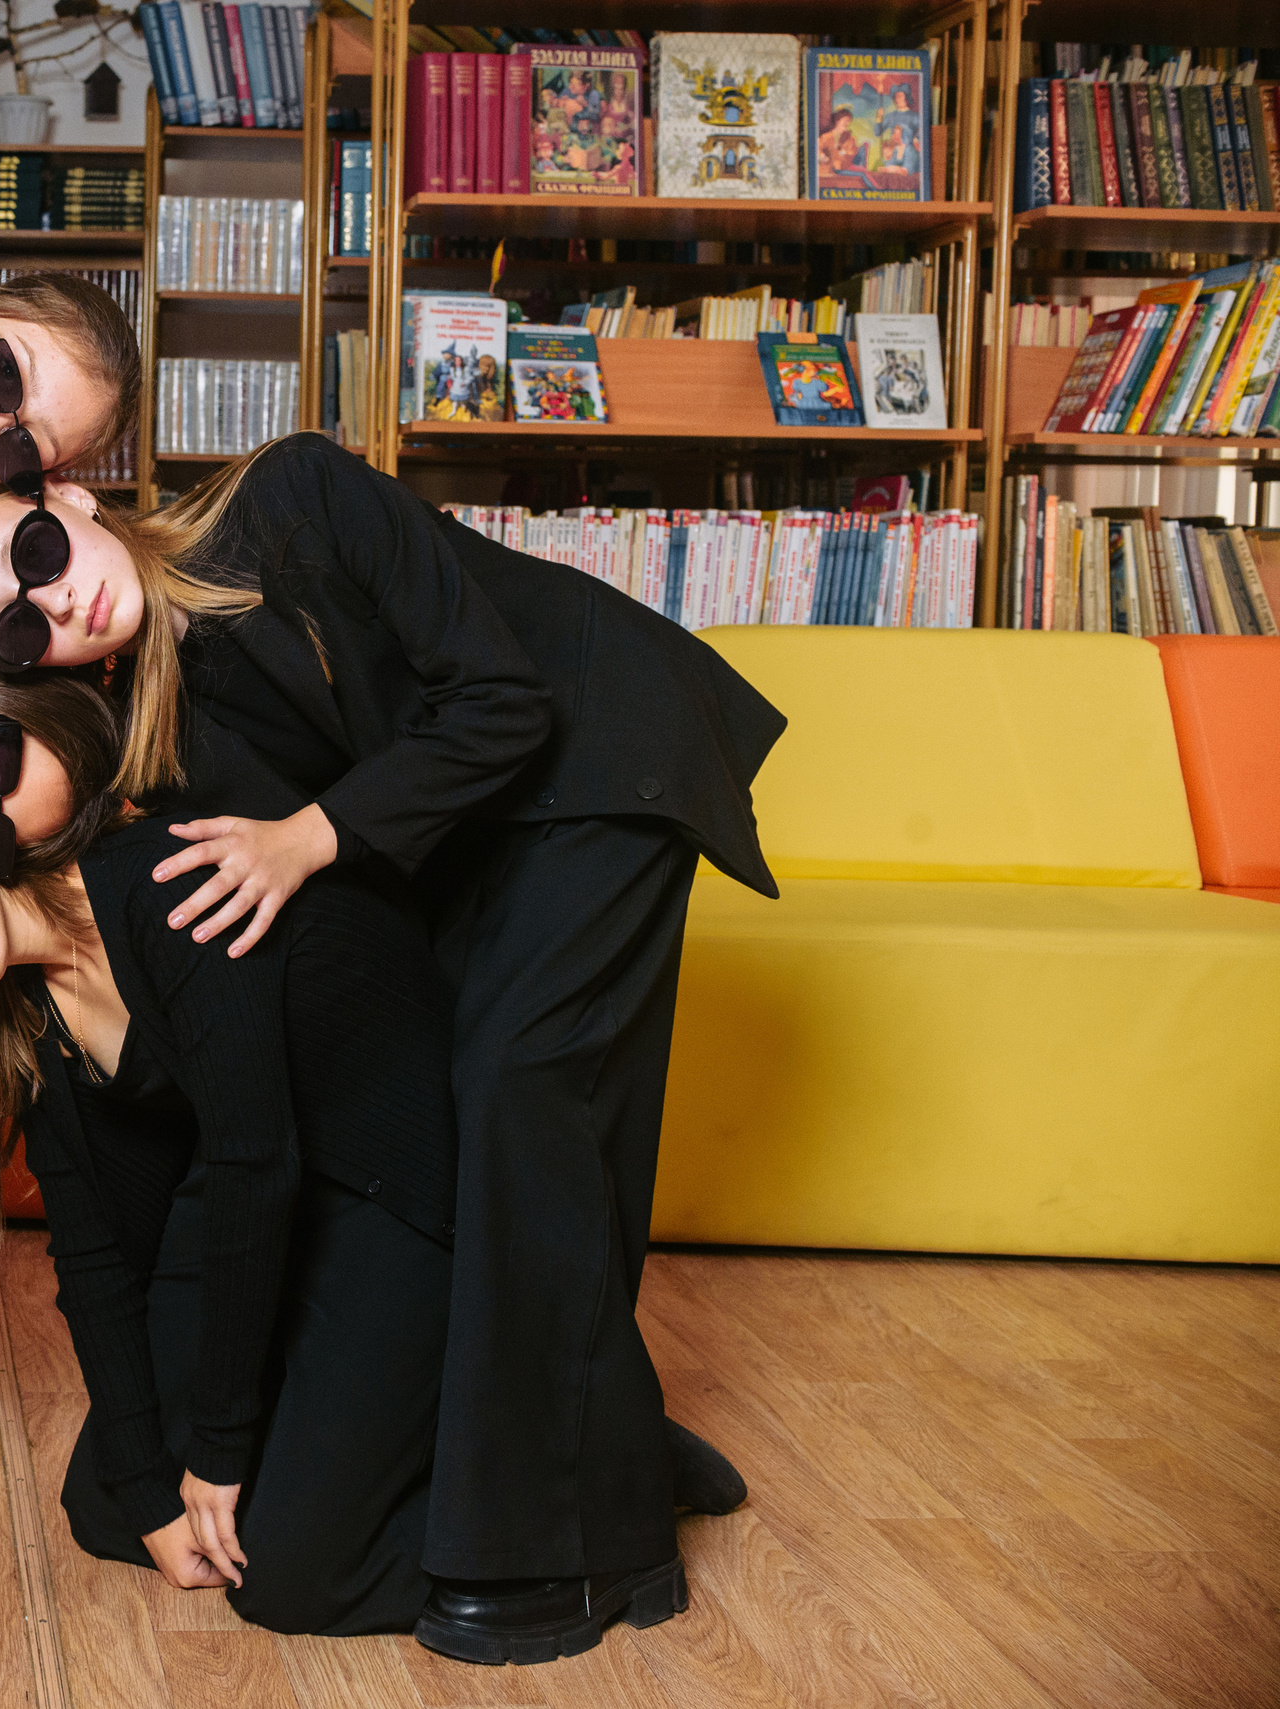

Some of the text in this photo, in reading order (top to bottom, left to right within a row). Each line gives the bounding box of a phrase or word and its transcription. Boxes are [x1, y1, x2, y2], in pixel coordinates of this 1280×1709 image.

[531, 49, 637, 67] ЗОЛОТАЯ КНИГА
[817, 53, 922, 70] ЗОЛОТАЯ КНИГА
[537, 182, 578, 193] СКАЗОК
[822, 190, 863, 199] СКАЗОК
